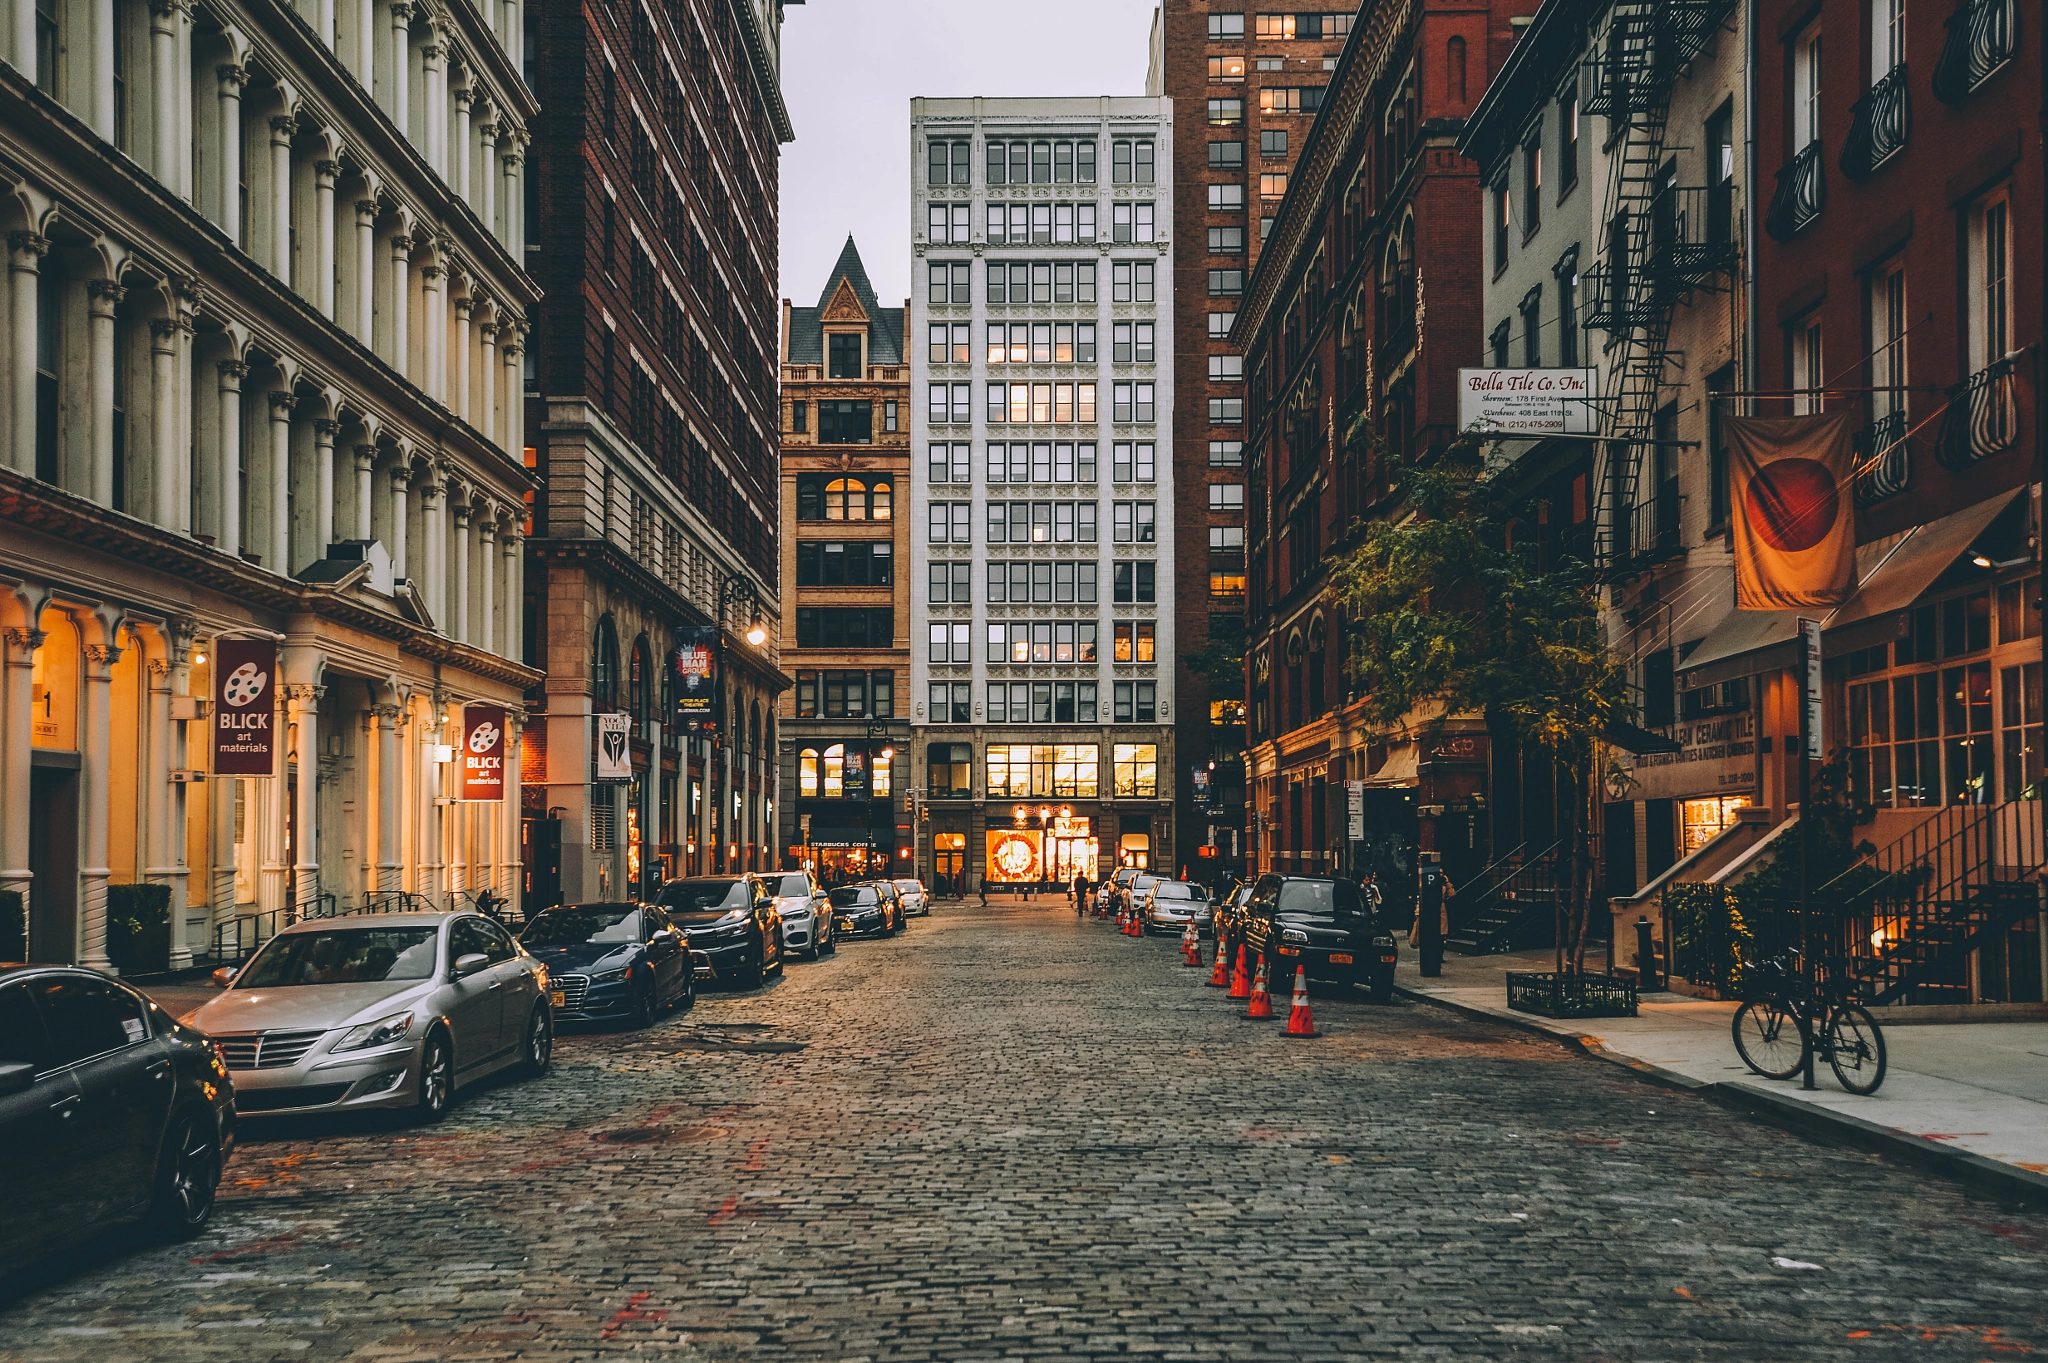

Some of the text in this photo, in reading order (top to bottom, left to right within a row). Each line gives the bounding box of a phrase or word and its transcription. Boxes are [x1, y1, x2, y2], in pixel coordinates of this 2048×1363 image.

[1468, 372, 1503, 390] Bella
[1508, 372, 1534, 390] Tile
[1537, 376, 1555, 390] Co.
[1482, 393, 1513, 402] Showroom:
[1482, 407, 1516, 416] Warehouse:
[1508, 421, 1527, 429] (212)
[682, 652, 707, 660] BLUE
[682, 660, 707, 668] MAN
[44, 691, 50, 718] 1
[220, 714, 268, 729] BLICK
[1697, 719, 1732, 746] CERAMIC
[1736, 716, 1754, 738] TILE
[237, 732, 252, 741] art
[220, 743, 268, 752] materials
[1727, 741, 1754, 758] CABINETS
[466, 757, 500, 768] BLICK
[653, 872, 659, 880] P
[1428, 875, 1435, 884] P
